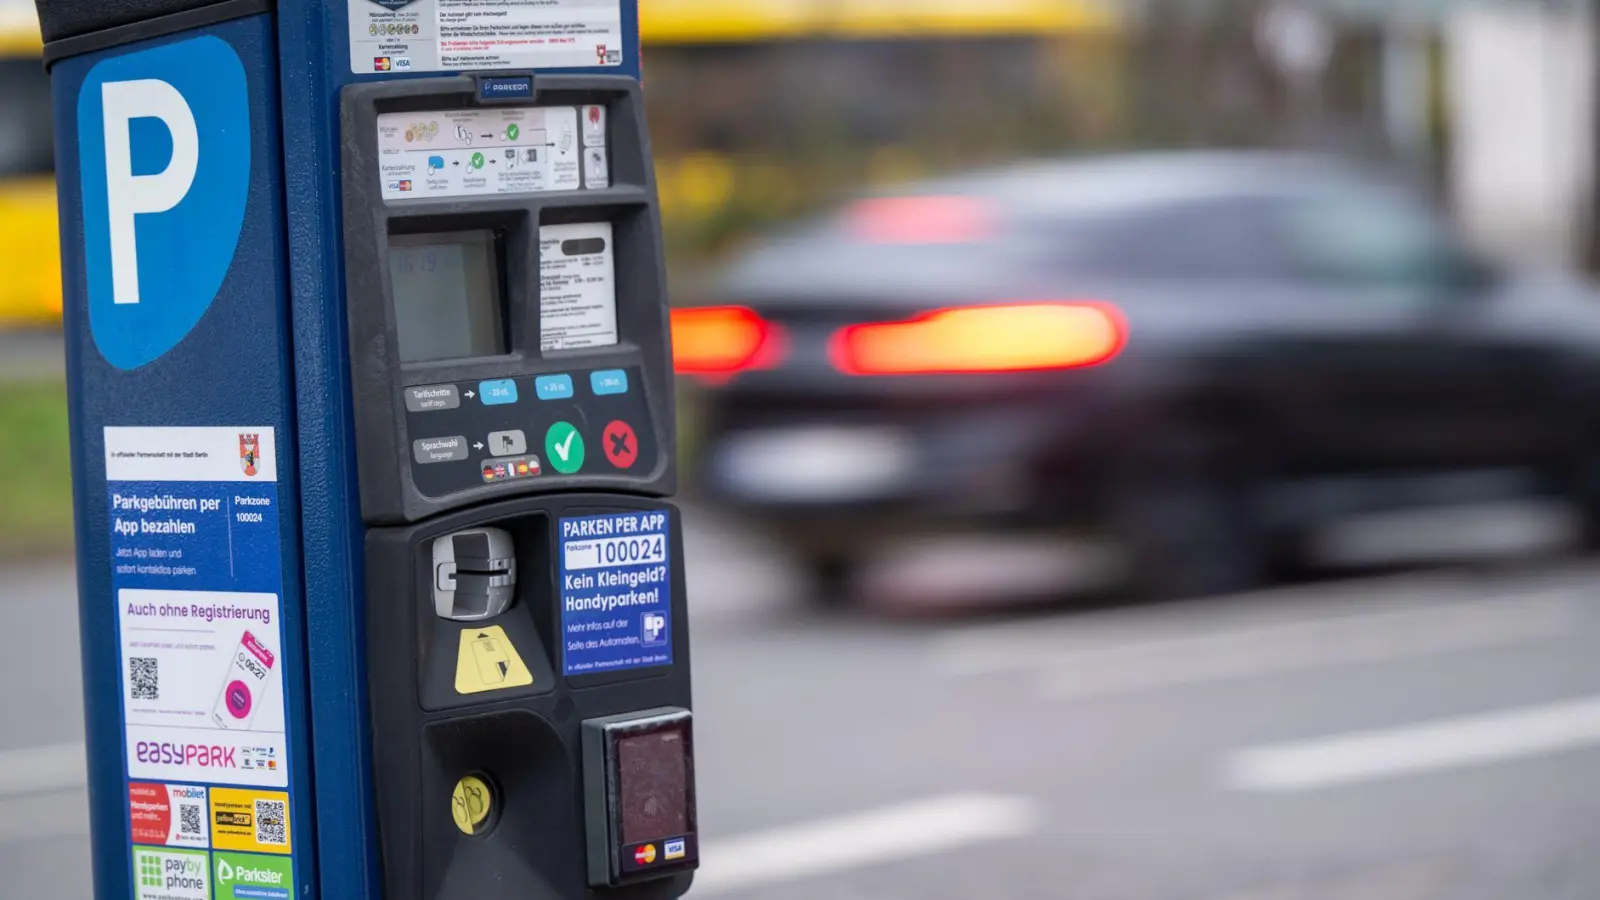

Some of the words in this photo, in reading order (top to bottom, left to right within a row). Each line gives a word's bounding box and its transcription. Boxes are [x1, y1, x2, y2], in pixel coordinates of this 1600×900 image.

[396, 59, 410, 67] VISA
[493, 82, 529, 92] PARKEON
[102, 79, 199, 304] P
[413, 389, 451, 399] Tarifschritte
[421, 438, 458, 452] Sprachwahl
[112, 494, 197, 512] Parkgebühren
[199, 498, 220, 513] per
[234, 496, 270, 506] Parkzone
[236, 512, 263, 523] 100024
[114, 518, 139, 536] App
[141, 518, 196, 533] bezahlen
[563, 518, 613, 537] PARKEN
[615, 515, 638, 534] PER
[640, 513, 665, 532] APP
[133, 549, 149, 559] App
[149, 549, 168, 558] laden
[169, 550, 182, 558] und
[566, 543, 592, 552] Parkzone
[595, 537, 662, 564] 100024
[117, 564, 137, 574] sofort
[173, 566, 197, 576] parken
[565, 573, 594, 590] Kein
[597, 566, 667, 588] Kleingeld?
[565, 587, 659, 612] Handyparken!
[127, 603, 157, 616] Auch
[160, 604, 189, 617] ohne
[191, 604, 271, 625] Registrierung
[567, 623, 586, 633] Mehr
[603, 620, 616, 630] auf
[616, 619, 629, 629] der
[567, 640, 585, 652] Seite
[585, 639, 599, 650] des
[599, 635, 640, 649] Automaten.
[245, 658, 266, 680] 09:27
[173, 788, 205, 799] mobilet
[130, 800, 169, 812] Handyparken
[131, 812, 144, 820] und
[236, 865, 283, 884] Parkster
[166, 875, 204, 891] phone
